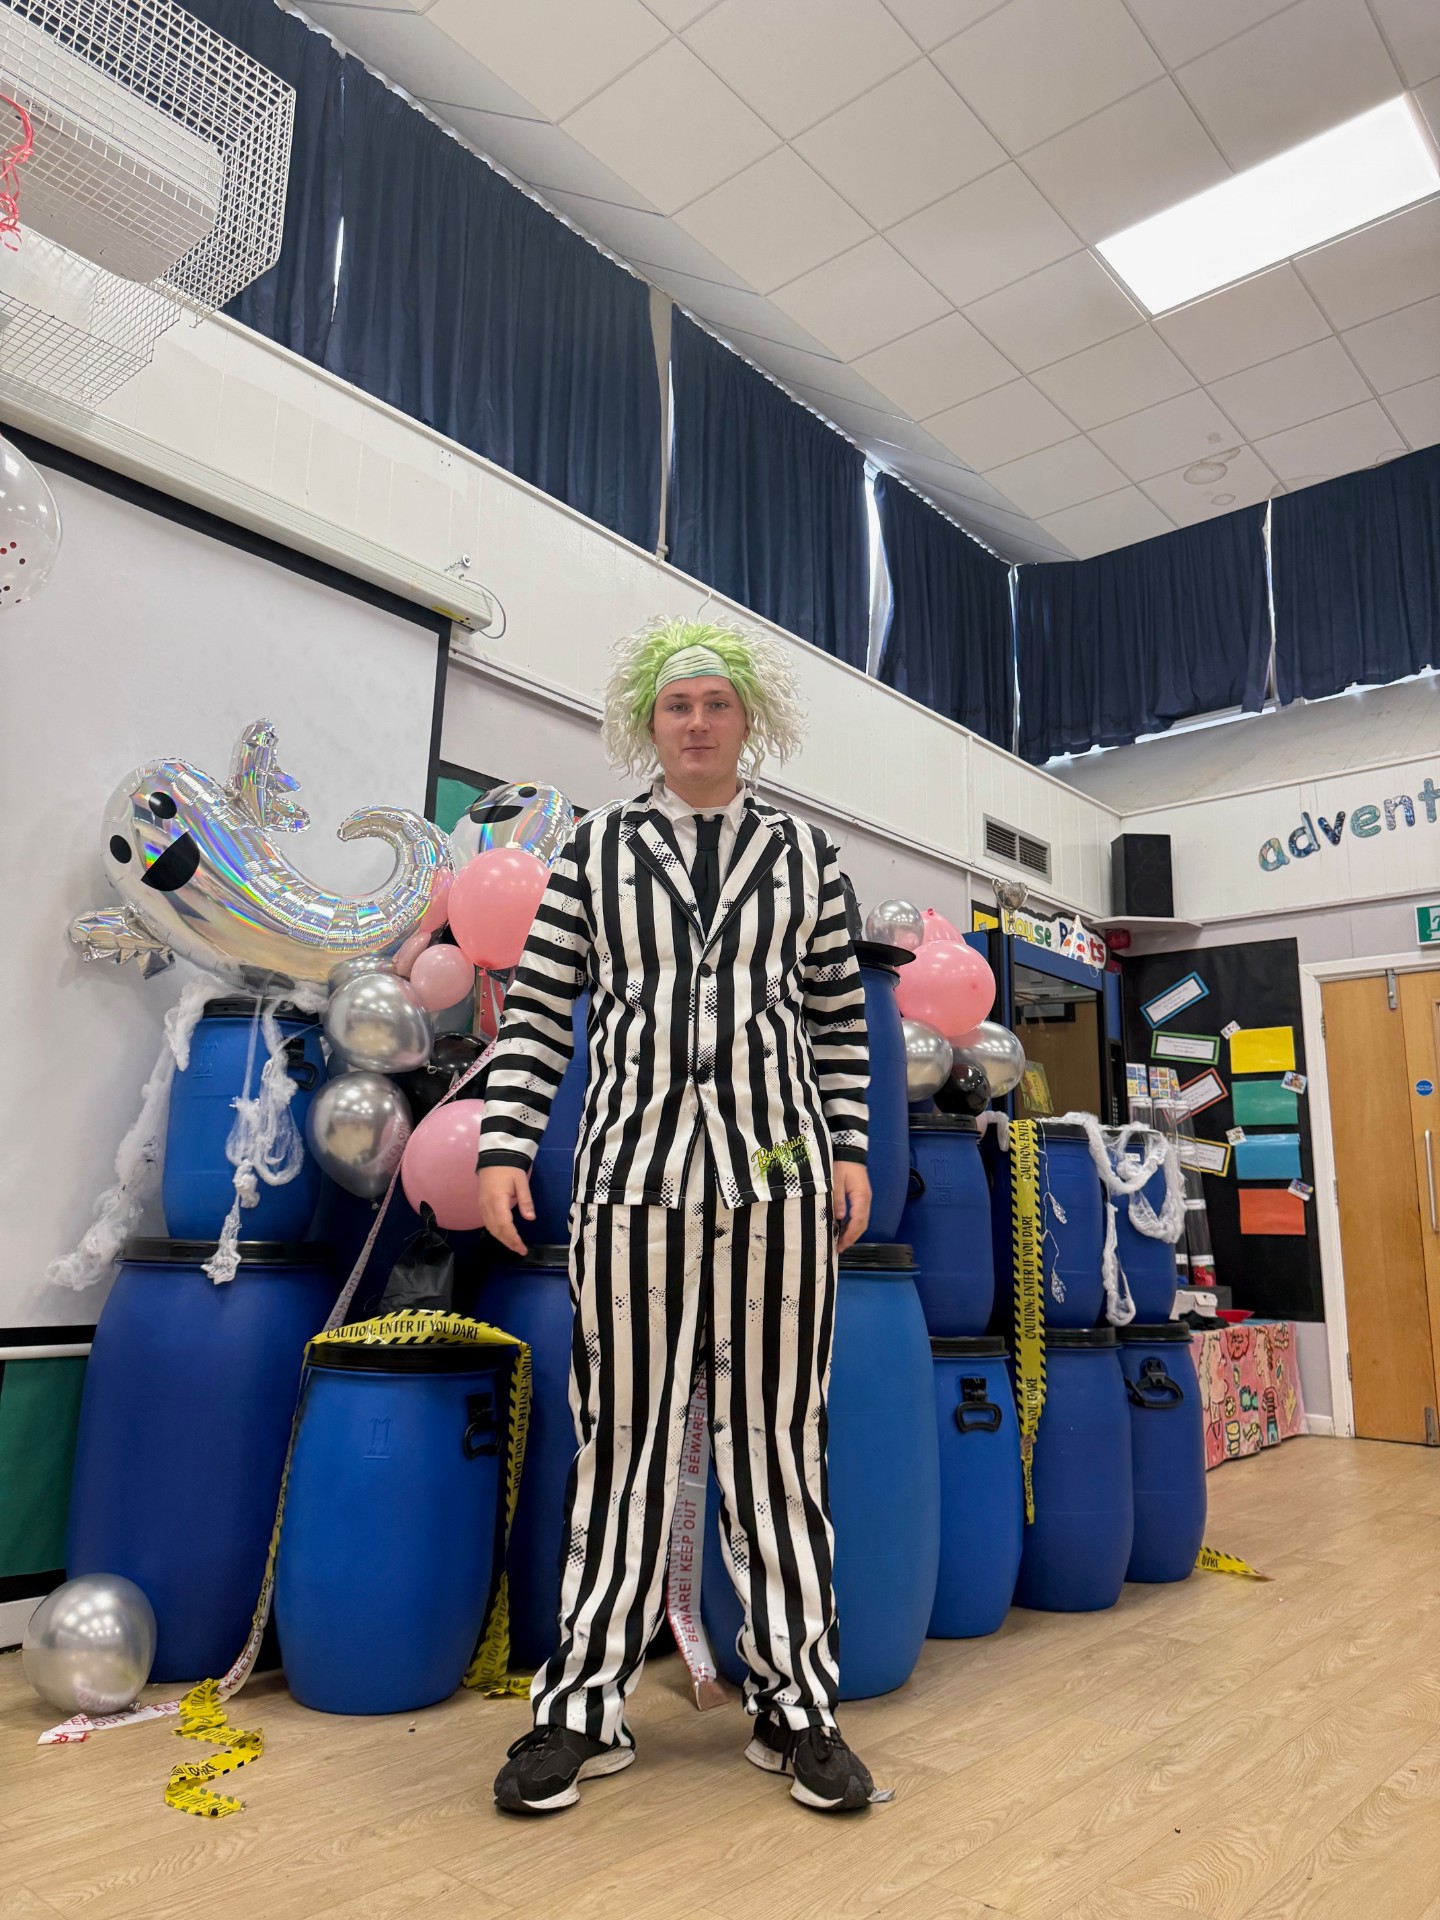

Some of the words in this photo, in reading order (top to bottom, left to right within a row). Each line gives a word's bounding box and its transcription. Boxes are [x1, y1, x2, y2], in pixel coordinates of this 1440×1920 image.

[1258, 778, 1440, 872] advent
[1020, 1142, 1031, 1180] CAUTION:
[1022, 1215, 1033, 1237] DARE
[1023, 1238, 1034, 1259] YOU
[1023, 1259, 1034, 1269] IF
[1024, 1269, 1035, 1296] ENTER
[326, 1325, 377, 1339] CAUTION:
[379, 1320, 414, 1335] ENTER
[417, 1320, 427, 1332] IF
[430, 1321, 450, 1335] YOU
[452, 1323, 480, 1340] DARE
[1025, 1298, 1036, 1339] CAUTION:
[1027, 1377, 1038, 1400] DARE
[1028, 1400, 1038, 1424] YOU
[688, 1404, 705, 1475] BEWARE!
[684, 1500, 697, 1530] OUT
[680, 1537, 695, 1573] KEEP
[679, 1578, 699, 1643] BEWARE!
